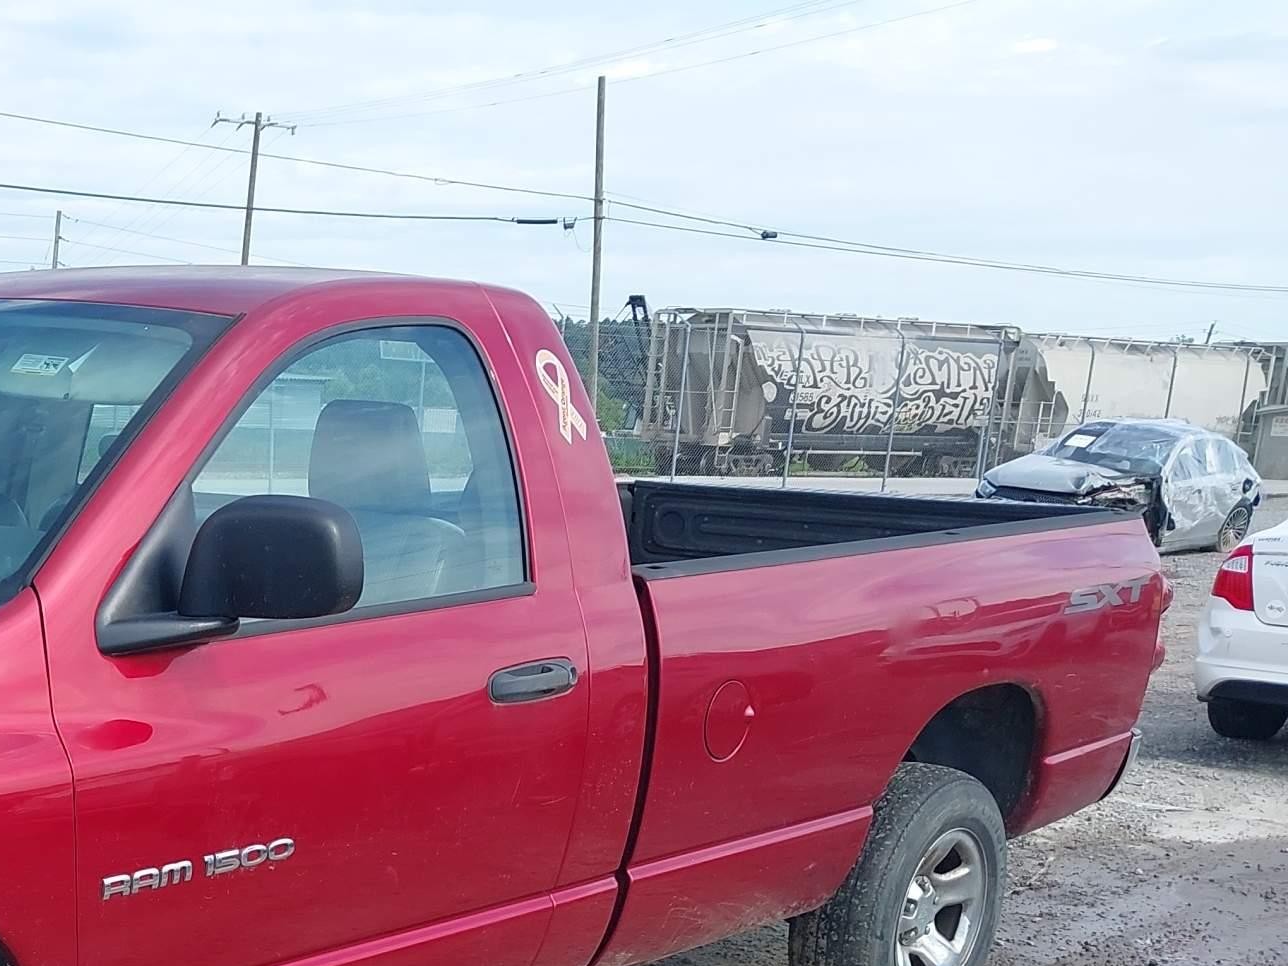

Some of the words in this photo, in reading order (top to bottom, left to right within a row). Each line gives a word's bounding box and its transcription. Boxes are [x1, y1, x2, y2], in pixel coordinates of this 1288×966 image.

[1063, 575, 1150, 615] SXT
[102, 859, 193, 901] RAM
[203, 836, 296, 877] 1500
